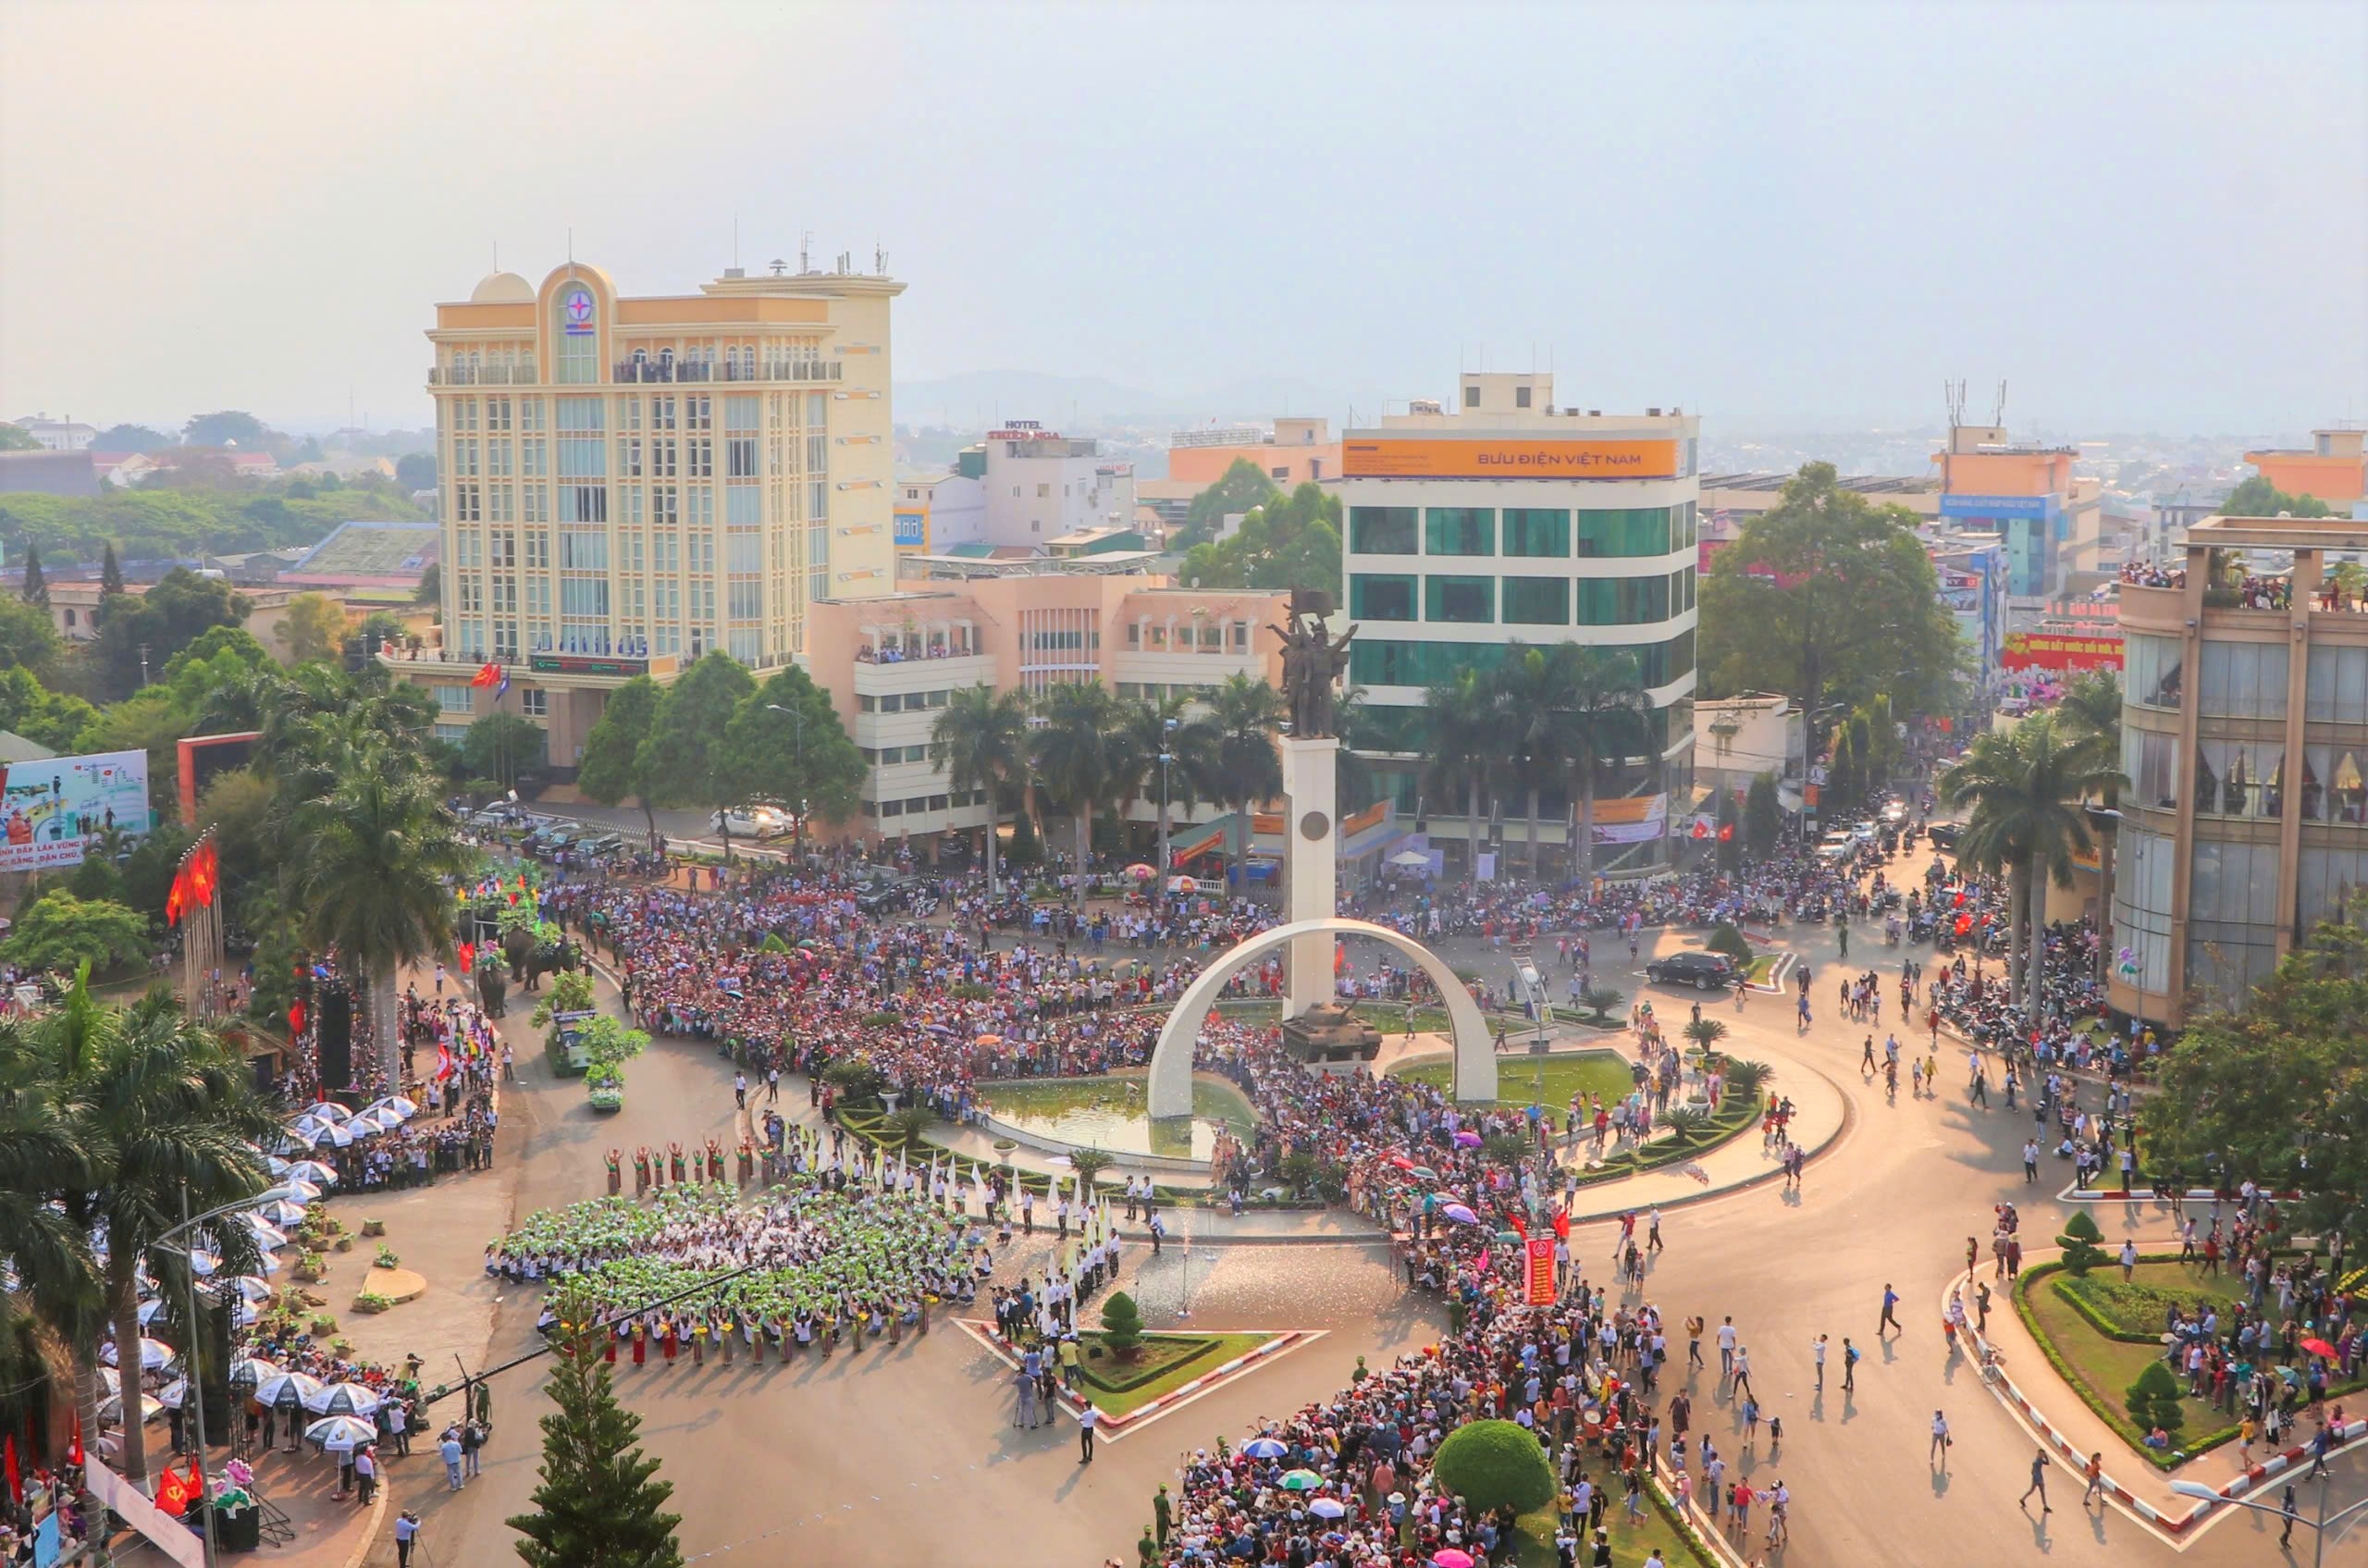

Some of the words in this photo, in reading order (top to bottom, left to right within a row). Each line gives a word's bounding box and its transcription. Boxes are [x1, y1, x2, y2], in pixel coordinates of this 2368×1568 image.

[1005, 420, 1042, 429] HOTEL
[1034, 431, 1061, 440] NGA
[1477, 451, 1514, 464] BƯU
[1518, 451, 1561, 468] ĐIỆN
[1564, 451, 1602, 467] VIỆT
[1605, 454, 1642, 465] NAM
